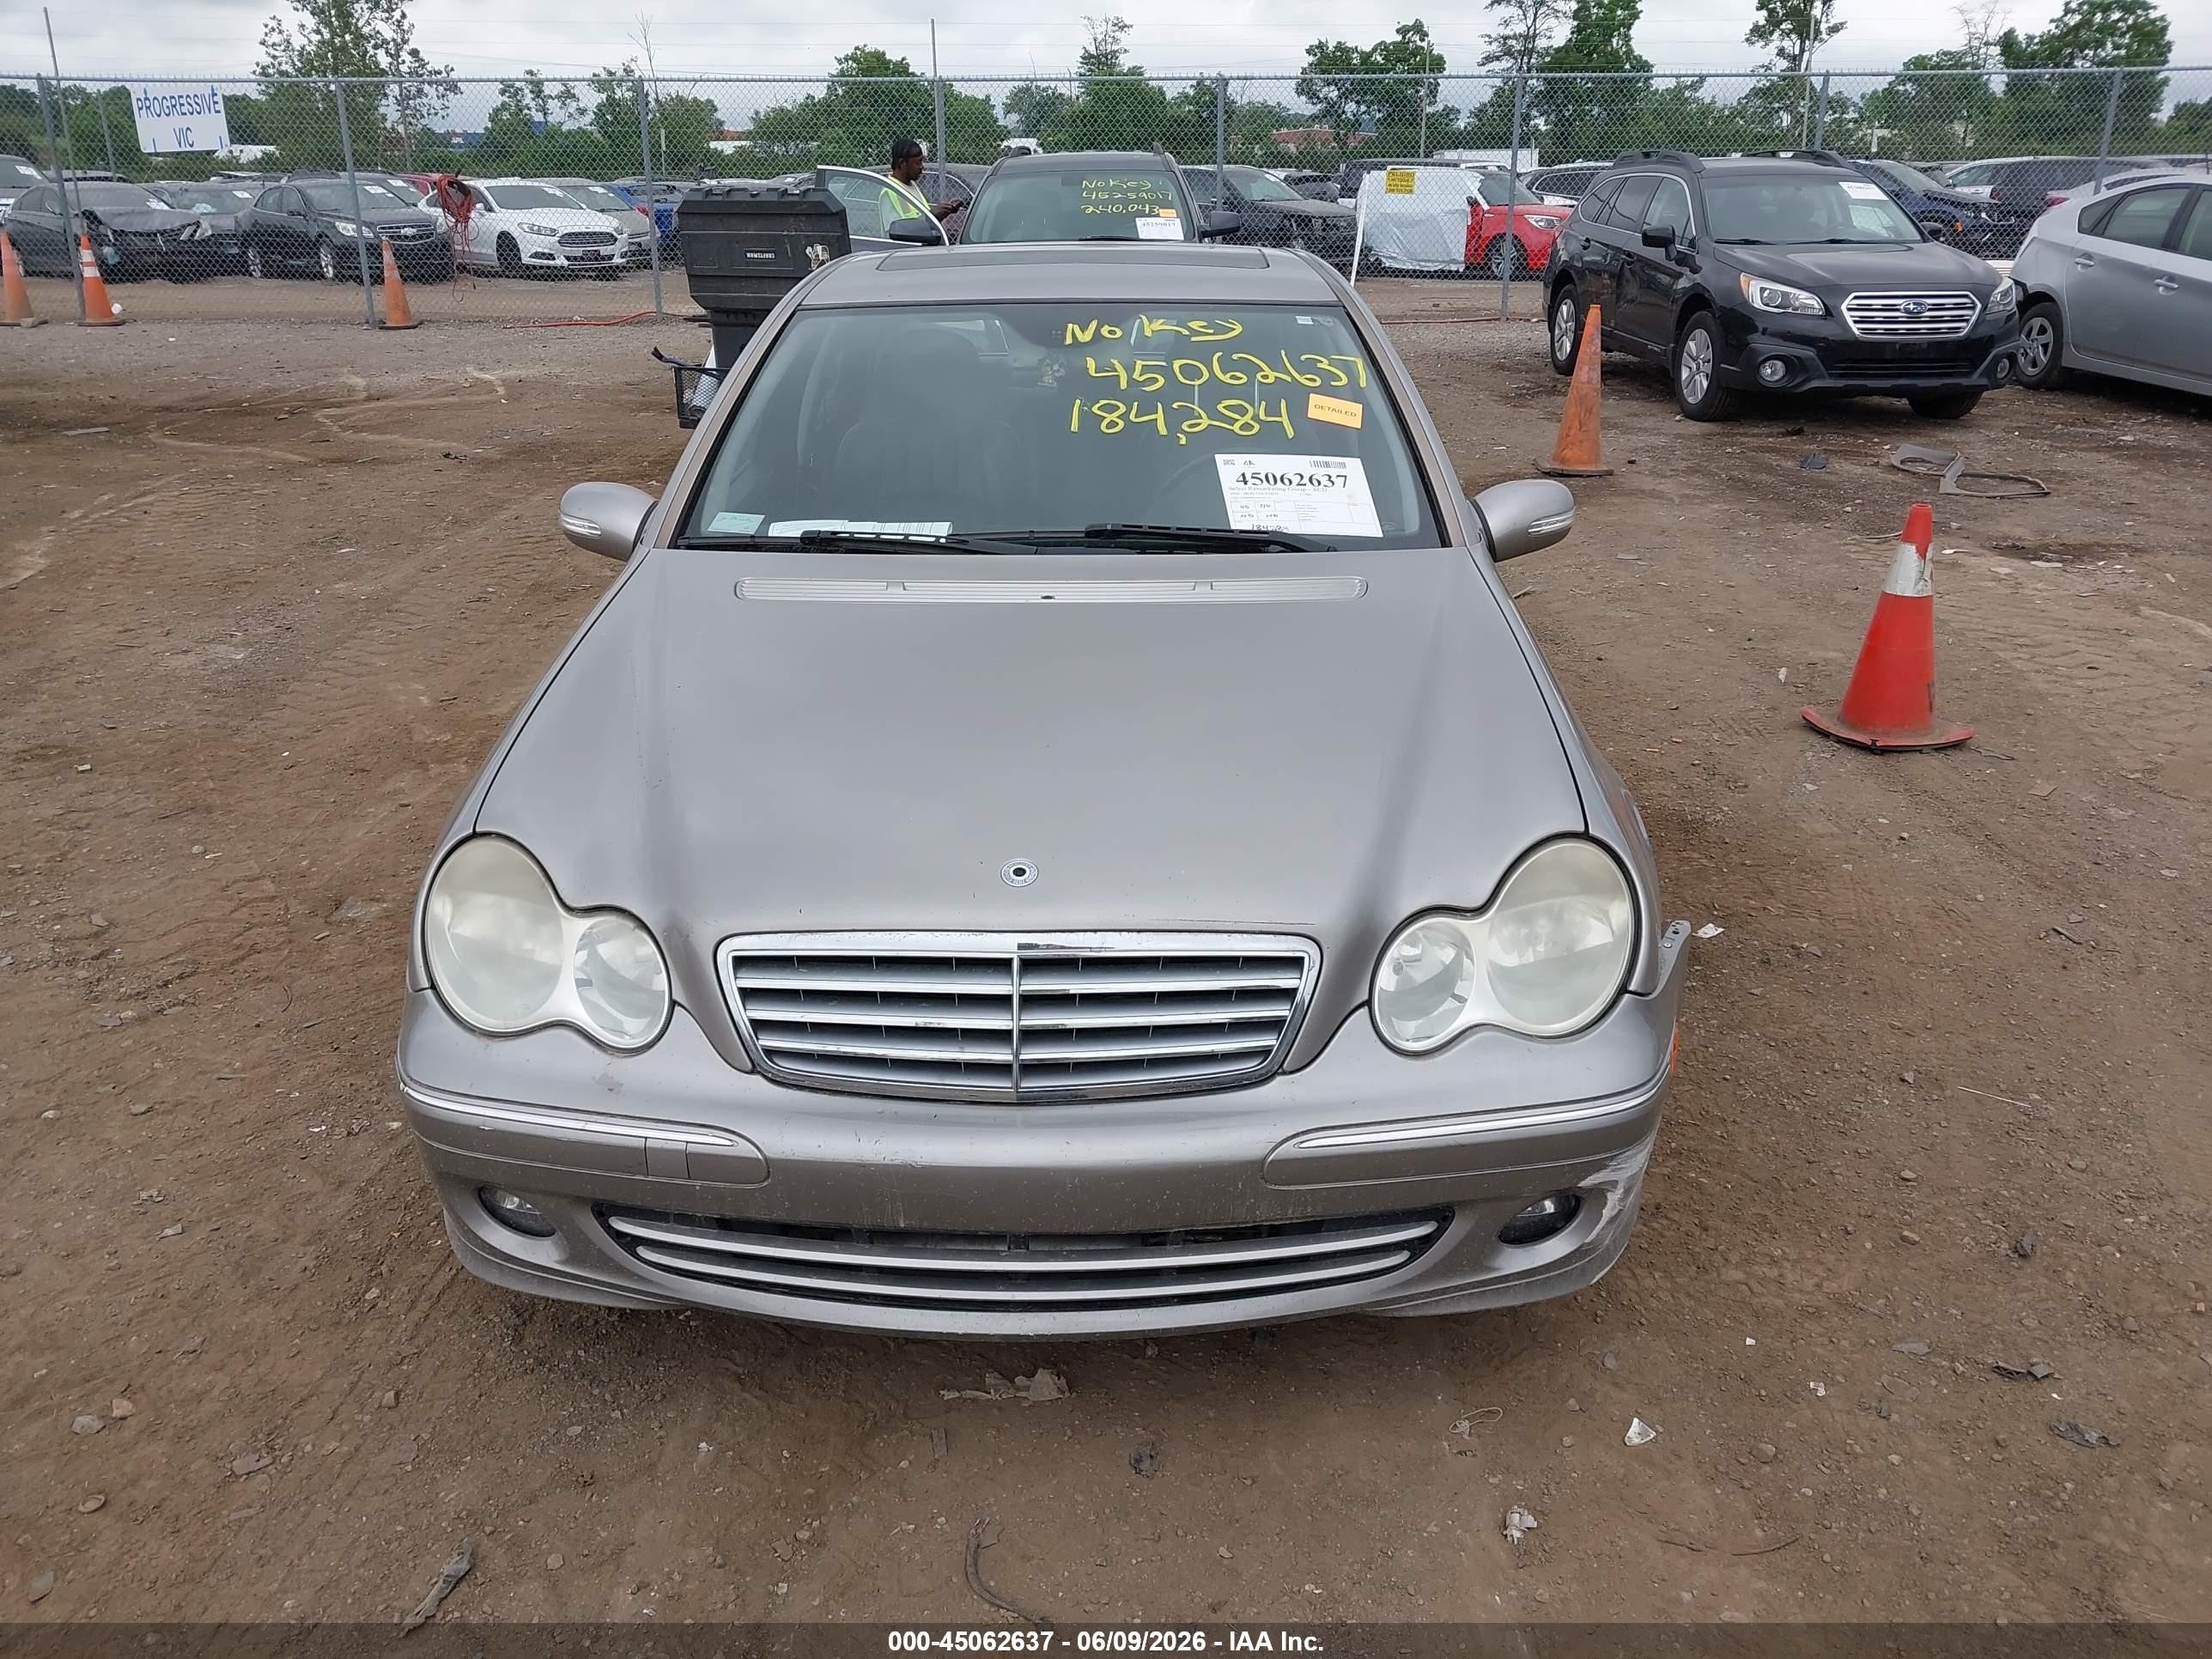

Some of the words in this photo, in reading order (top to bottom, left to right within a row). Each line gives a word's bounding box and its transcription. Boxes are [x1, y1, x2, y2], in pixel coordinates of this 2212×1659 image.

[136, 92, 222, 118] PROGRESSIVE
[173, 127, 194, 149] VIC
[1082, 191, 1172, 201] 45259017
[1081, 204, 1160, 215] 240,043
[1085, 349, 1368, 392] 45062637
[1314, 404, 1357, 417] DETAILED
[1070, 398, 1295, 446] 184,284
[1236, 471, 1348, 489] 45062637
